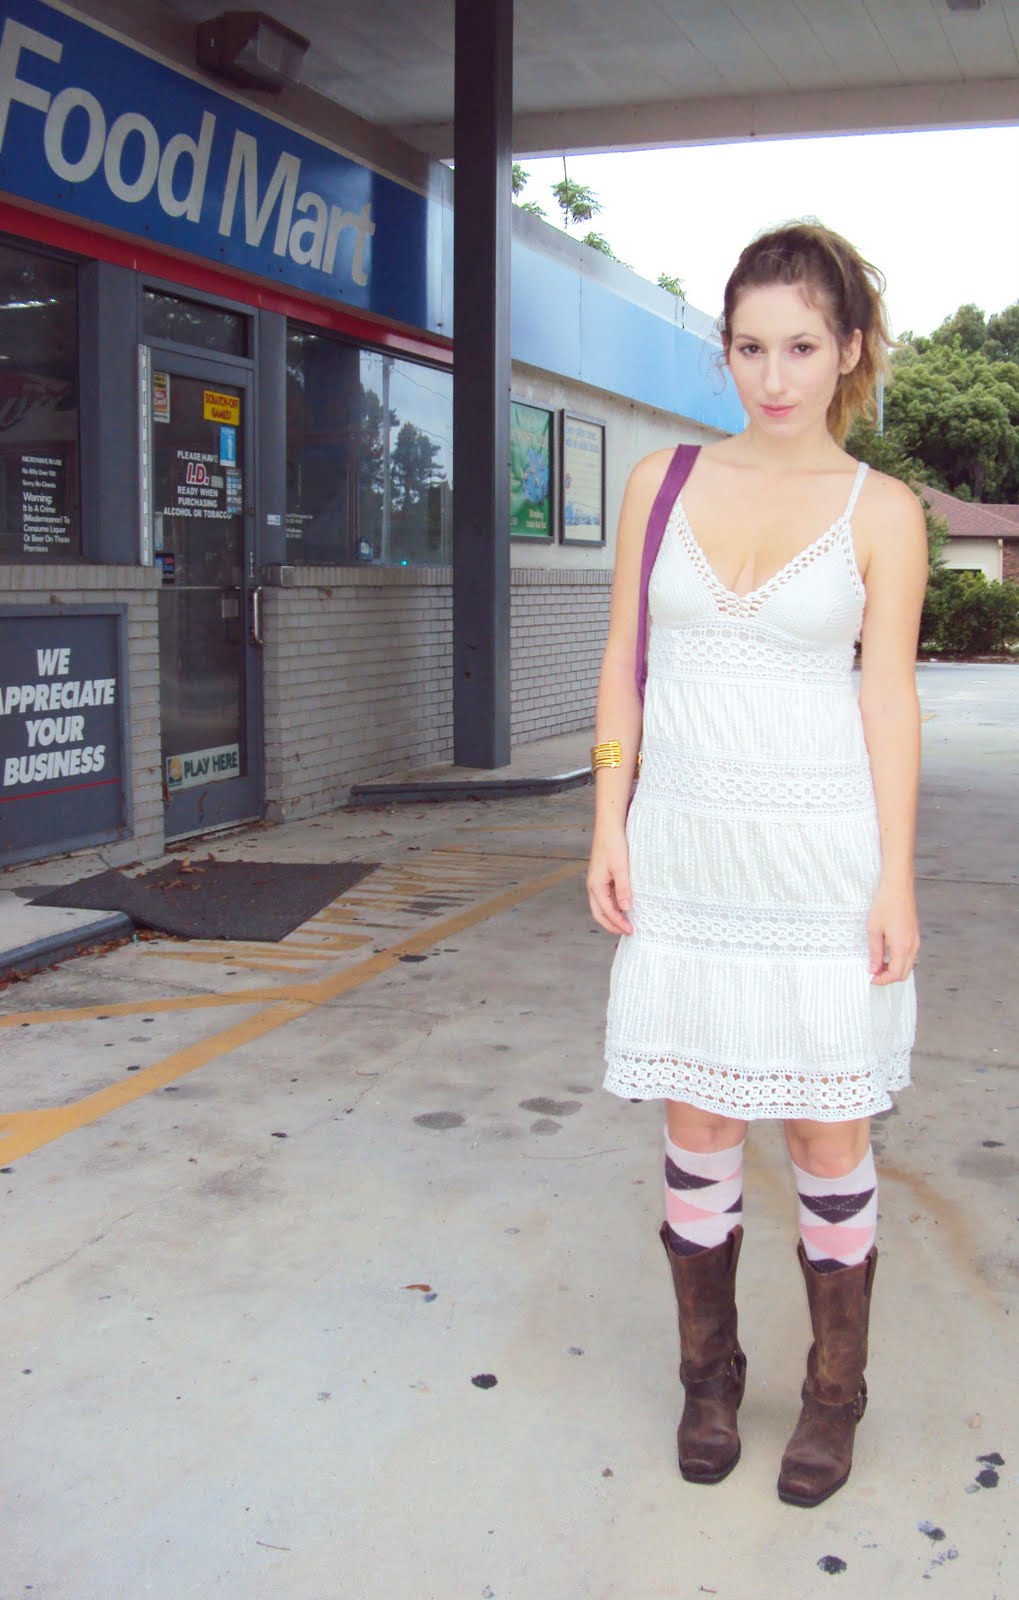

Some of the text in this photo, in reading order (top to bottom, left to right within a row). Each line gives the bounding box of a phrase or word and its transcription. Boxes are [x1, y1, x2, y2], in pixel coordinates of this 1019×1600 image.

[0, 18, 375, 286] Food Mart
[177, 450, 218, 463] PLEASE HAVE
[186, 462, 210, 485] I.D.
[177, 485, 218, 498] READY WHEN
[178, 496, 218, 508] PURCHASING
[23, 504, 28, 512] It
[34, 504, 39, 513] A
[40, 504, 56, 514] Crime
[164, 507, 192, 517] ALCOHOL
[193, 508, 203, 518] OR
[63, 515, 70, 524] To
[23, 524, 66, 535] Consume Liquor
[23, 533, 31, 542] Or
[31, 534, 44, 543] Beer
[45, 534, 54, 543] On
[37, 648, 71, 676] WE
[25, 715, 84, 747] YOUR
[3, 745, 106, 786] BUSINESS
[184, 751, 238, 778] PLAY HERE
